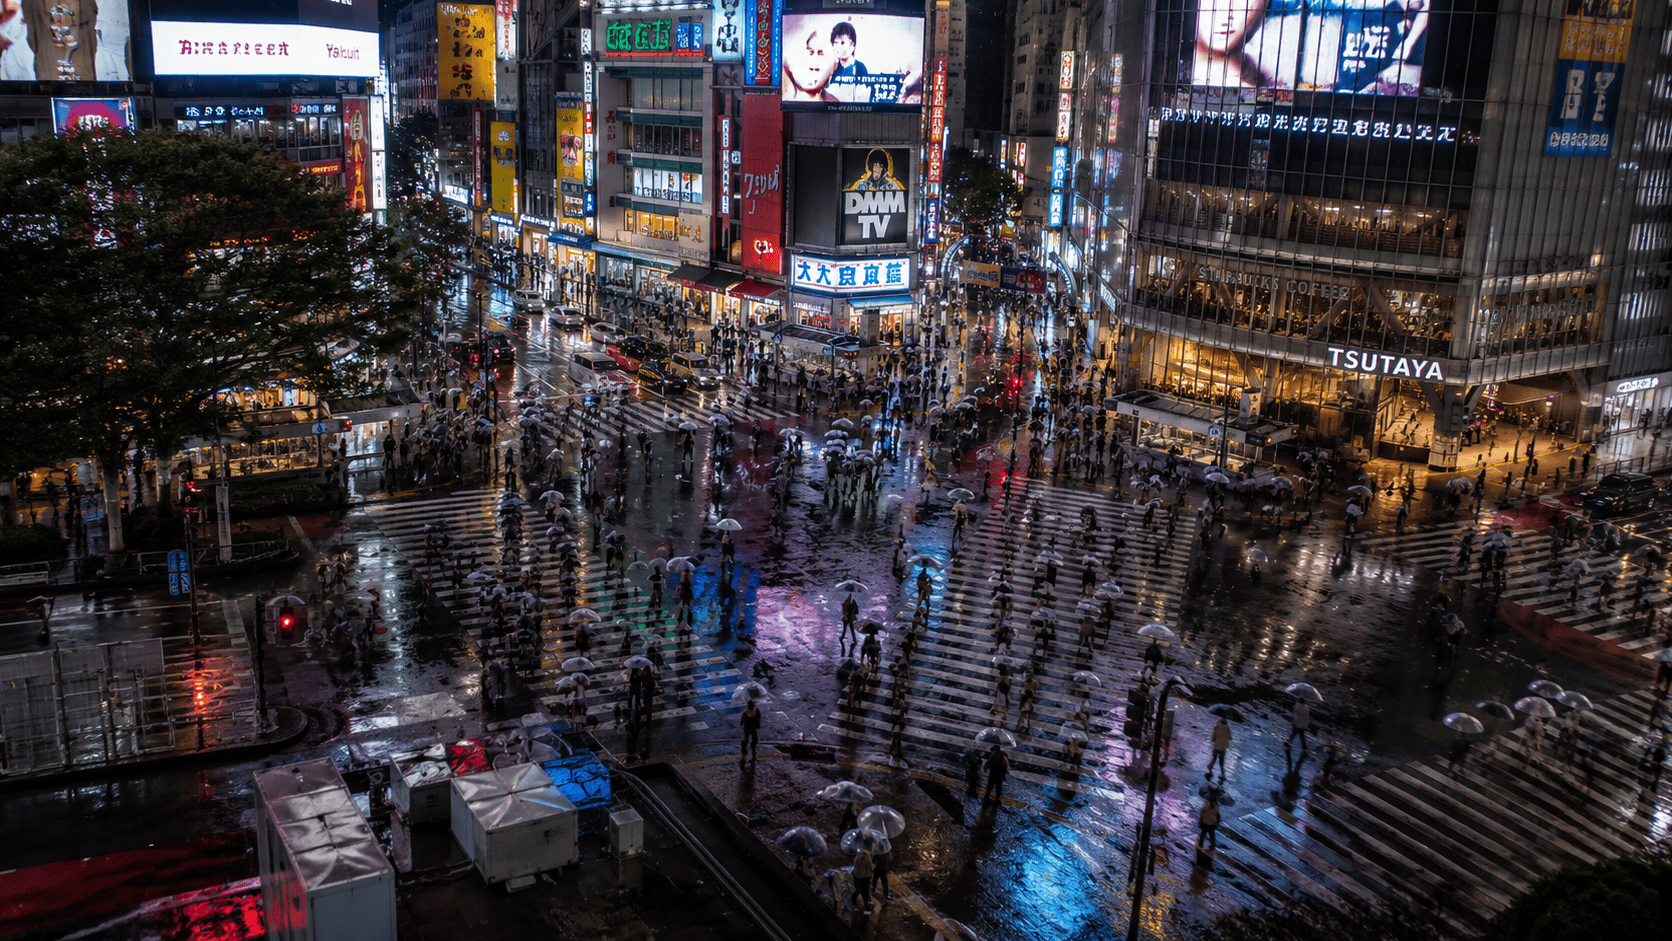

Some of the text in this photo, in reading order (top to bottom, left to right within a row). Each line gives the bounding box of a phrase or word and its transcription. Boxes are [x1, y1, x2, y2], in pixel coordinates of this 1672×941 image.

[845, 191, 906, 215] DMM
[858, 214, 891, 238] TV
[1328, 347, 1444, 381] TSUTAYA
